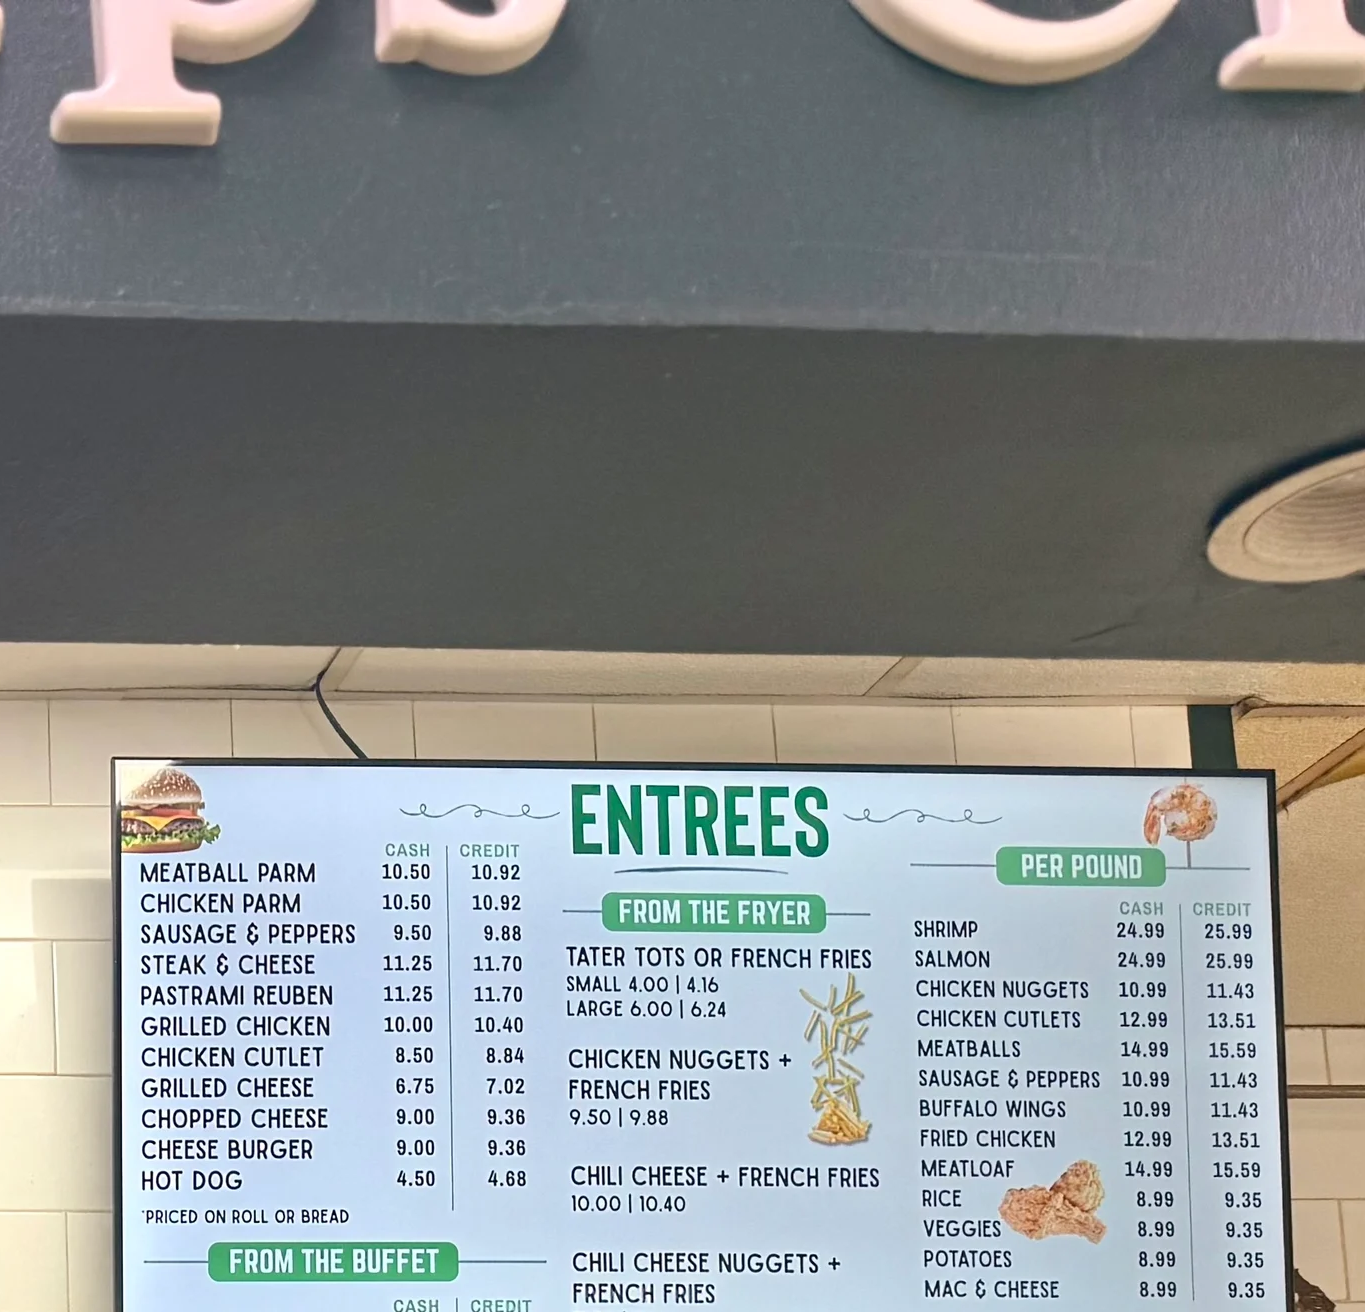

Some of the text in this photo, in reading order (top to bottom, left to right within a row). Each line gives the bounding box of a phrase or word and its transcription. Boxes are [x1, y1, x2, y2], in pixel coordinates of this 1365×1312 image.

[570, 784, 829, 858] ENTREES
[141, 863, 520, 883] MEATBALL PARM 10.50 10.92
[1022, 854, 1142, 879] PER POUND
[914, 920, 1252, 939] SHRIMP 24.99 25.99
[566, 946, 871, 969] TATER TOTS OR FRENCH FRIES
[142, 1170, 242, 1191] HOT DOG
[923, 1220, 1001, 1237] VEGGIES
[230, 1248, 439, 1273] FROM THE BUFFET
[925, 1279, 1265, 1299] MAC & CHEESE 8.99 9.35
